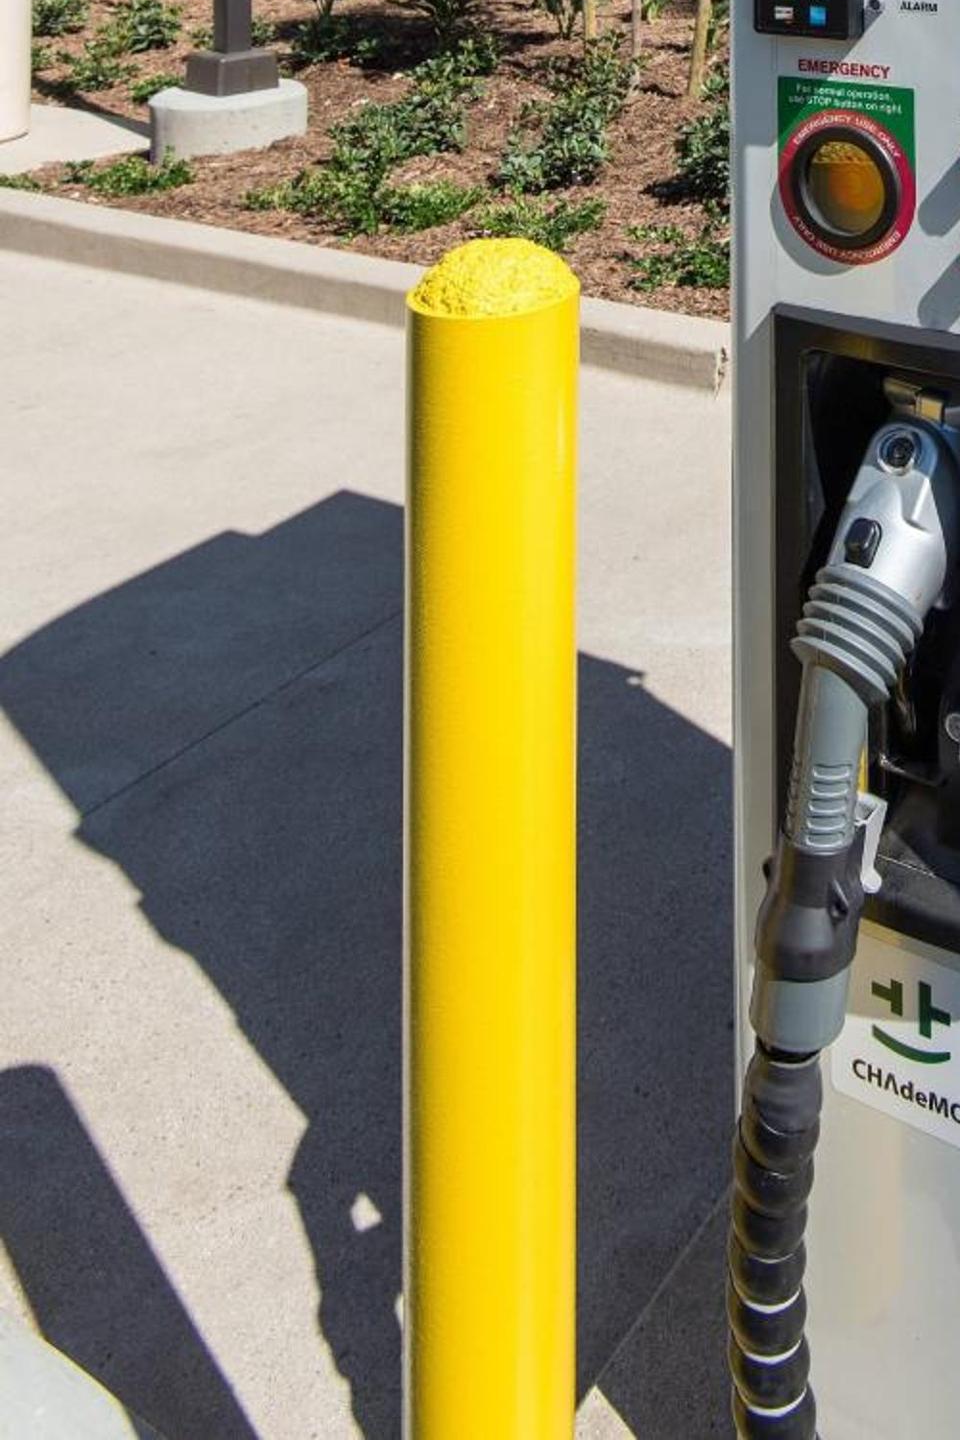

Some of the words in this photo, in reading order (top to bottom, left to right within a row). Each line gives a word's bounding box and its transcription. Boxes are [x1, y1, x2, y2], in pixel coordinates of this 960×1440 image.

[900, 1, 938, 12] ALARM
[798, 59, 890, 79] EMERGENCY
[807, 95, 832, 106] STOP
